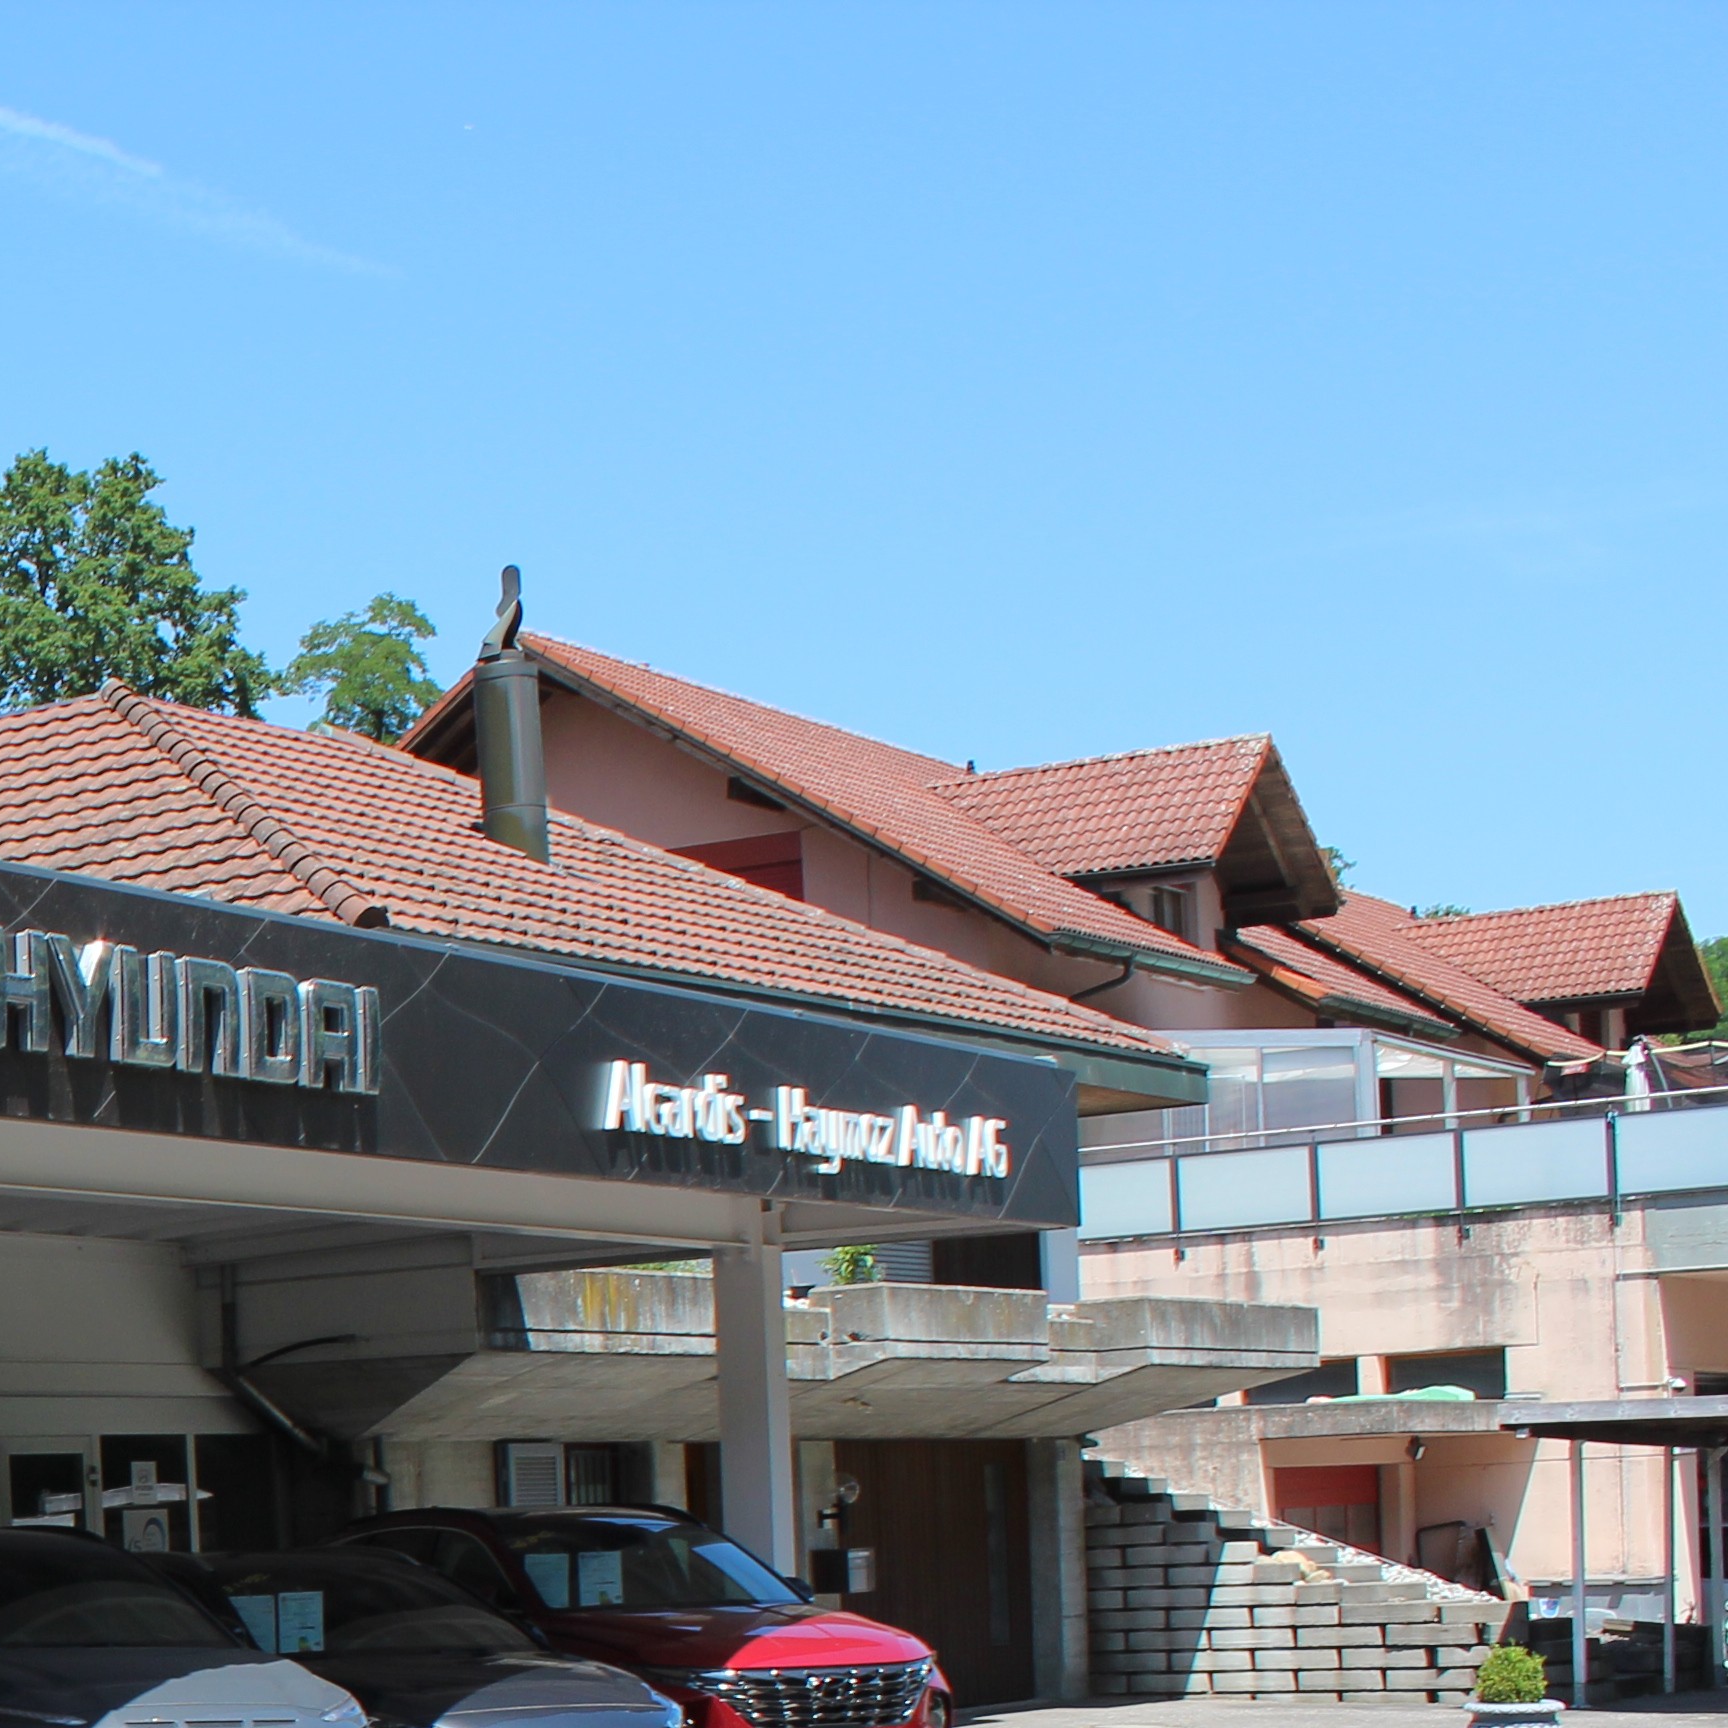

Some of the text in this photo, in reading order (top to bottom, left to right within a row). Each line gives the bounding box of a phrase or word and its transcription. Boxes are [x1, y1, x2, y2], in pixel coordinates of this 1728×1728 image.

[600, 1058, 746, 1145] Alcardis
[775, 1085, 897, 1174] Haymoz
[894, 1104, 964, 1174] Auto
[964, 1114, 1010, 1179] AG
